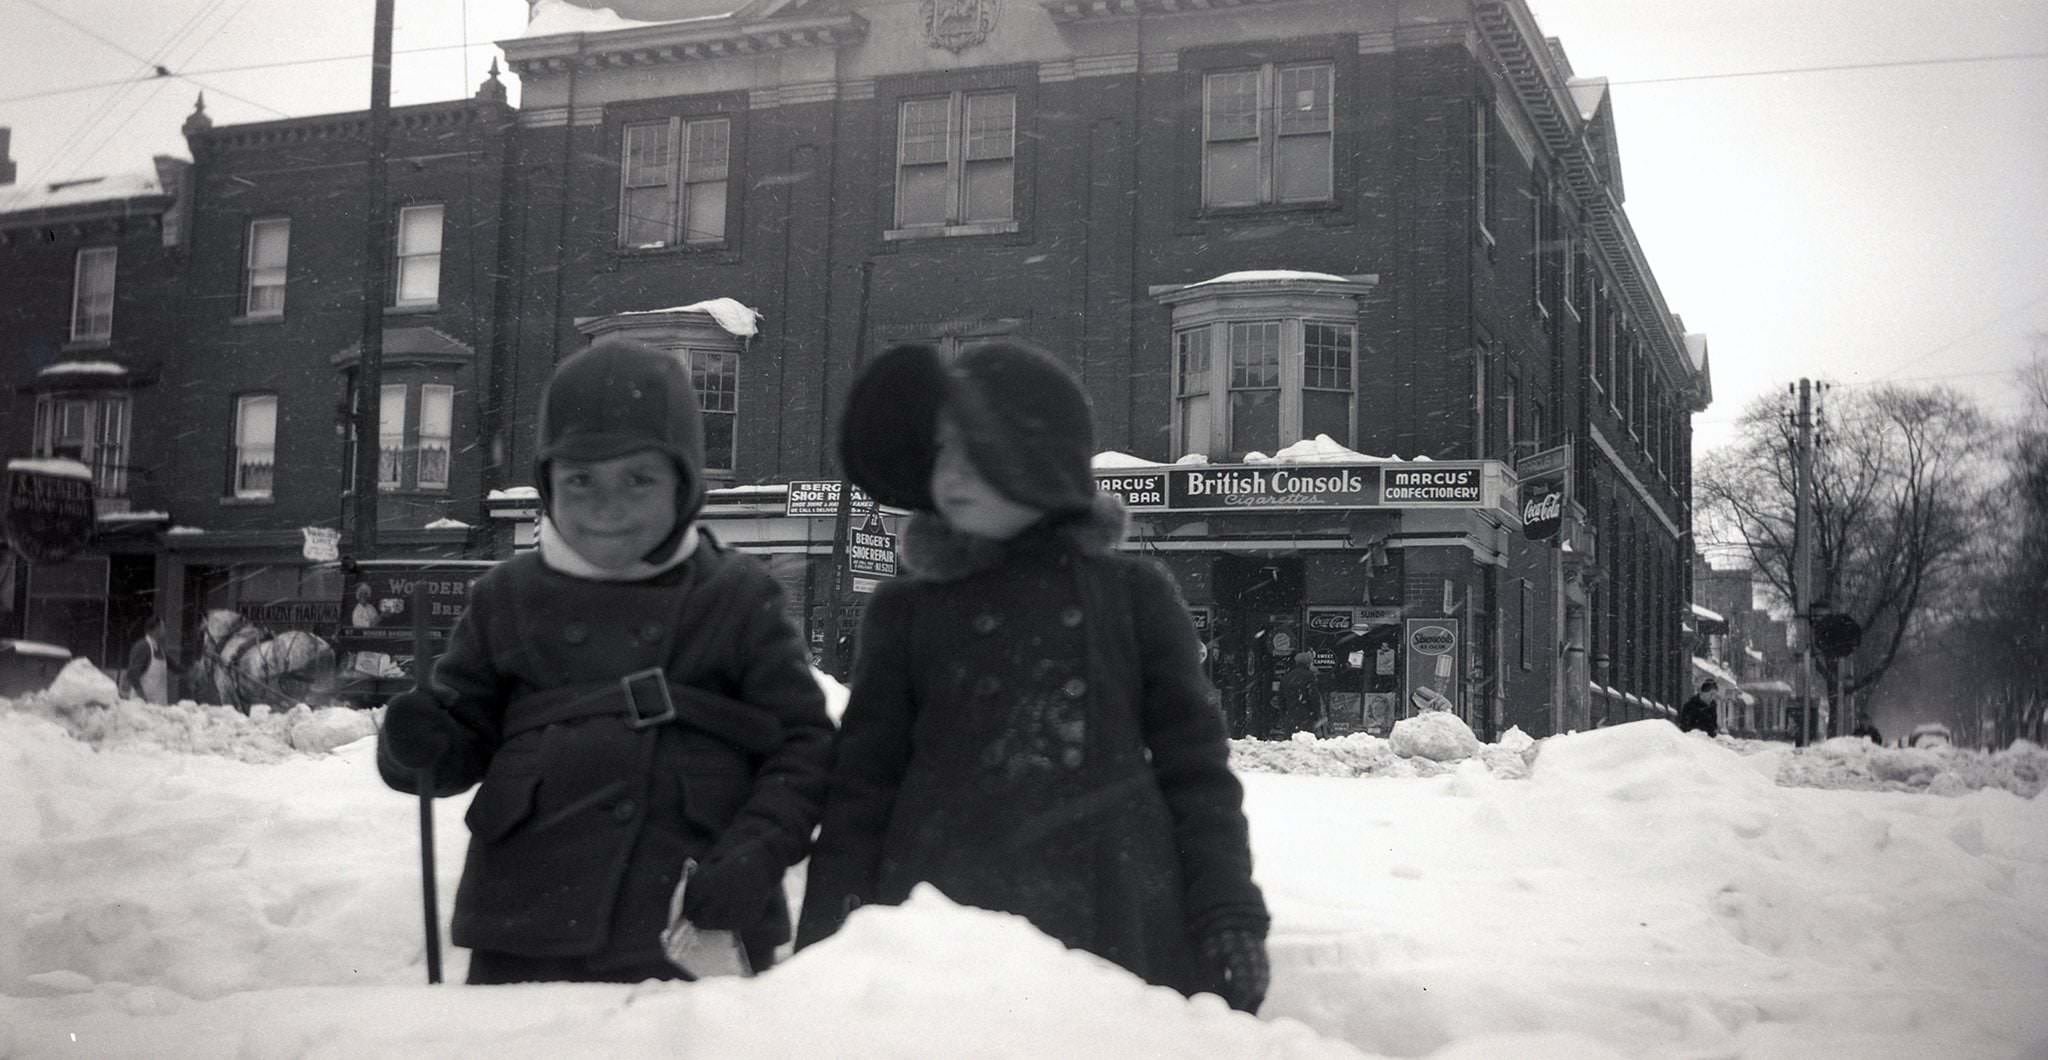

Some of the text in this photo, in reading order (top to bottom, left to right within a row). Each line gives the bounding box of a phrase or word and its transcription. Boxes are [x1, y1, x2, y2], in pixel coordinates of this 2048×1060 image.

[1188, 470, 1362, 495] British Consols
[792, 491, 824, 501] SHOE
[1129, 492, 1160, 503] BAR
[1224, 493, 1318, 507] Cigarettes
[1386, 487, 1479, 500] CONFECTIONERY
[856, 533, 891, 547] BERGER'S
[852, 546, 894, 562] SHOE REPAIR
[389, 578, 465, 594] WODER
